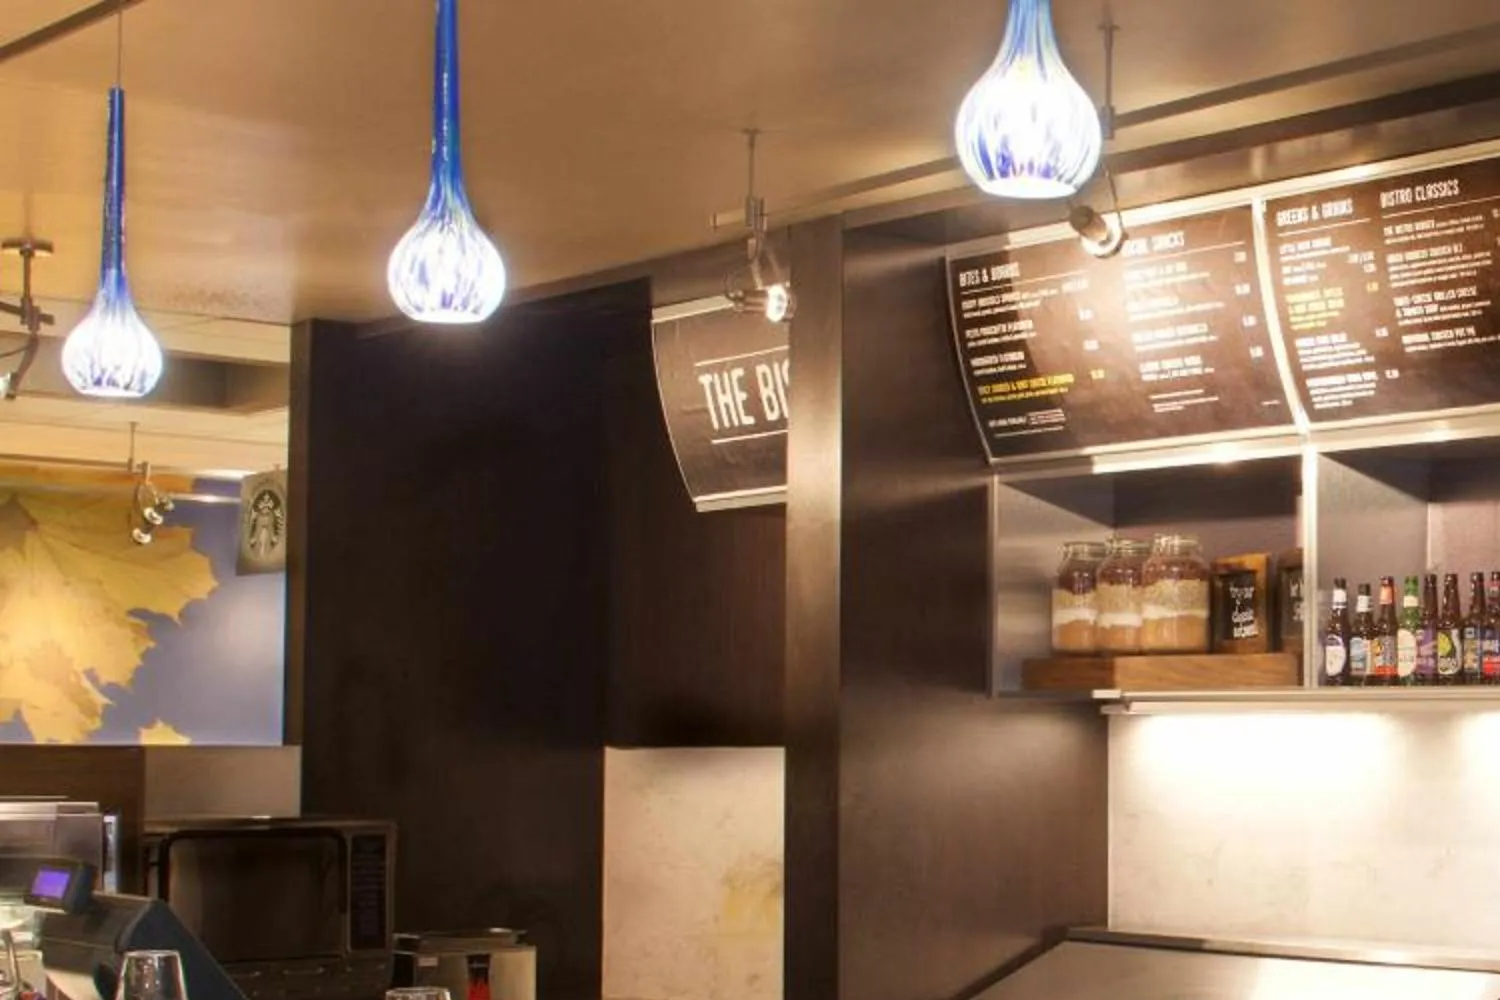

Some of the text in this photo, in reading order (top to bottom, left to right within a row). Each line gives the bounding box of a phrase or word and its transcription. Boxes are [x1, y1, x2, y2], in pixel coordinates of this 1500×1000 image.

[1380, 178, 1459, 209] BISTRO CLASSICS
[698, 367, 755, 430] THE
